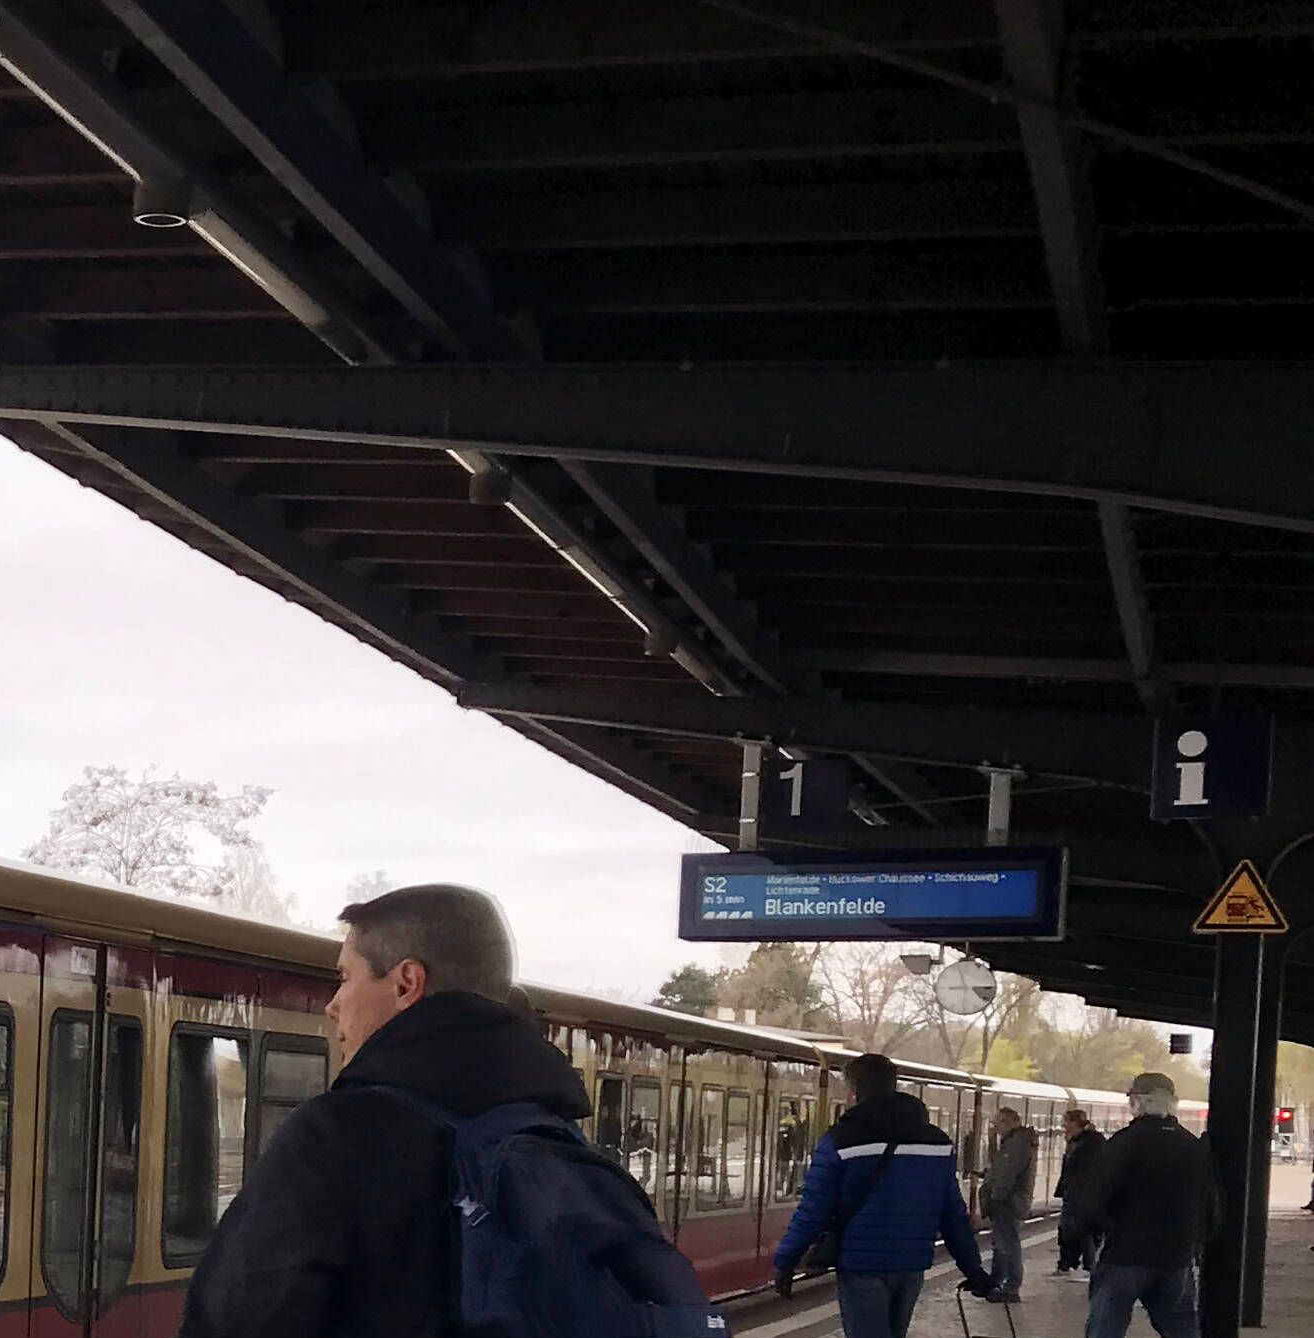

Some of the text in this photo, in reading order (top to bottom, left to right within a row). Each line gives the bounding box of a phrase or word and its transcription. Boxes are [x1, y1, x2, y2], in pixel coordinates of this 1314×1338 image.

[778, 762, 804, 817] 1
[703, 876, 728, 893] S2
[765, 897, 886, 916] Blankenfelde
